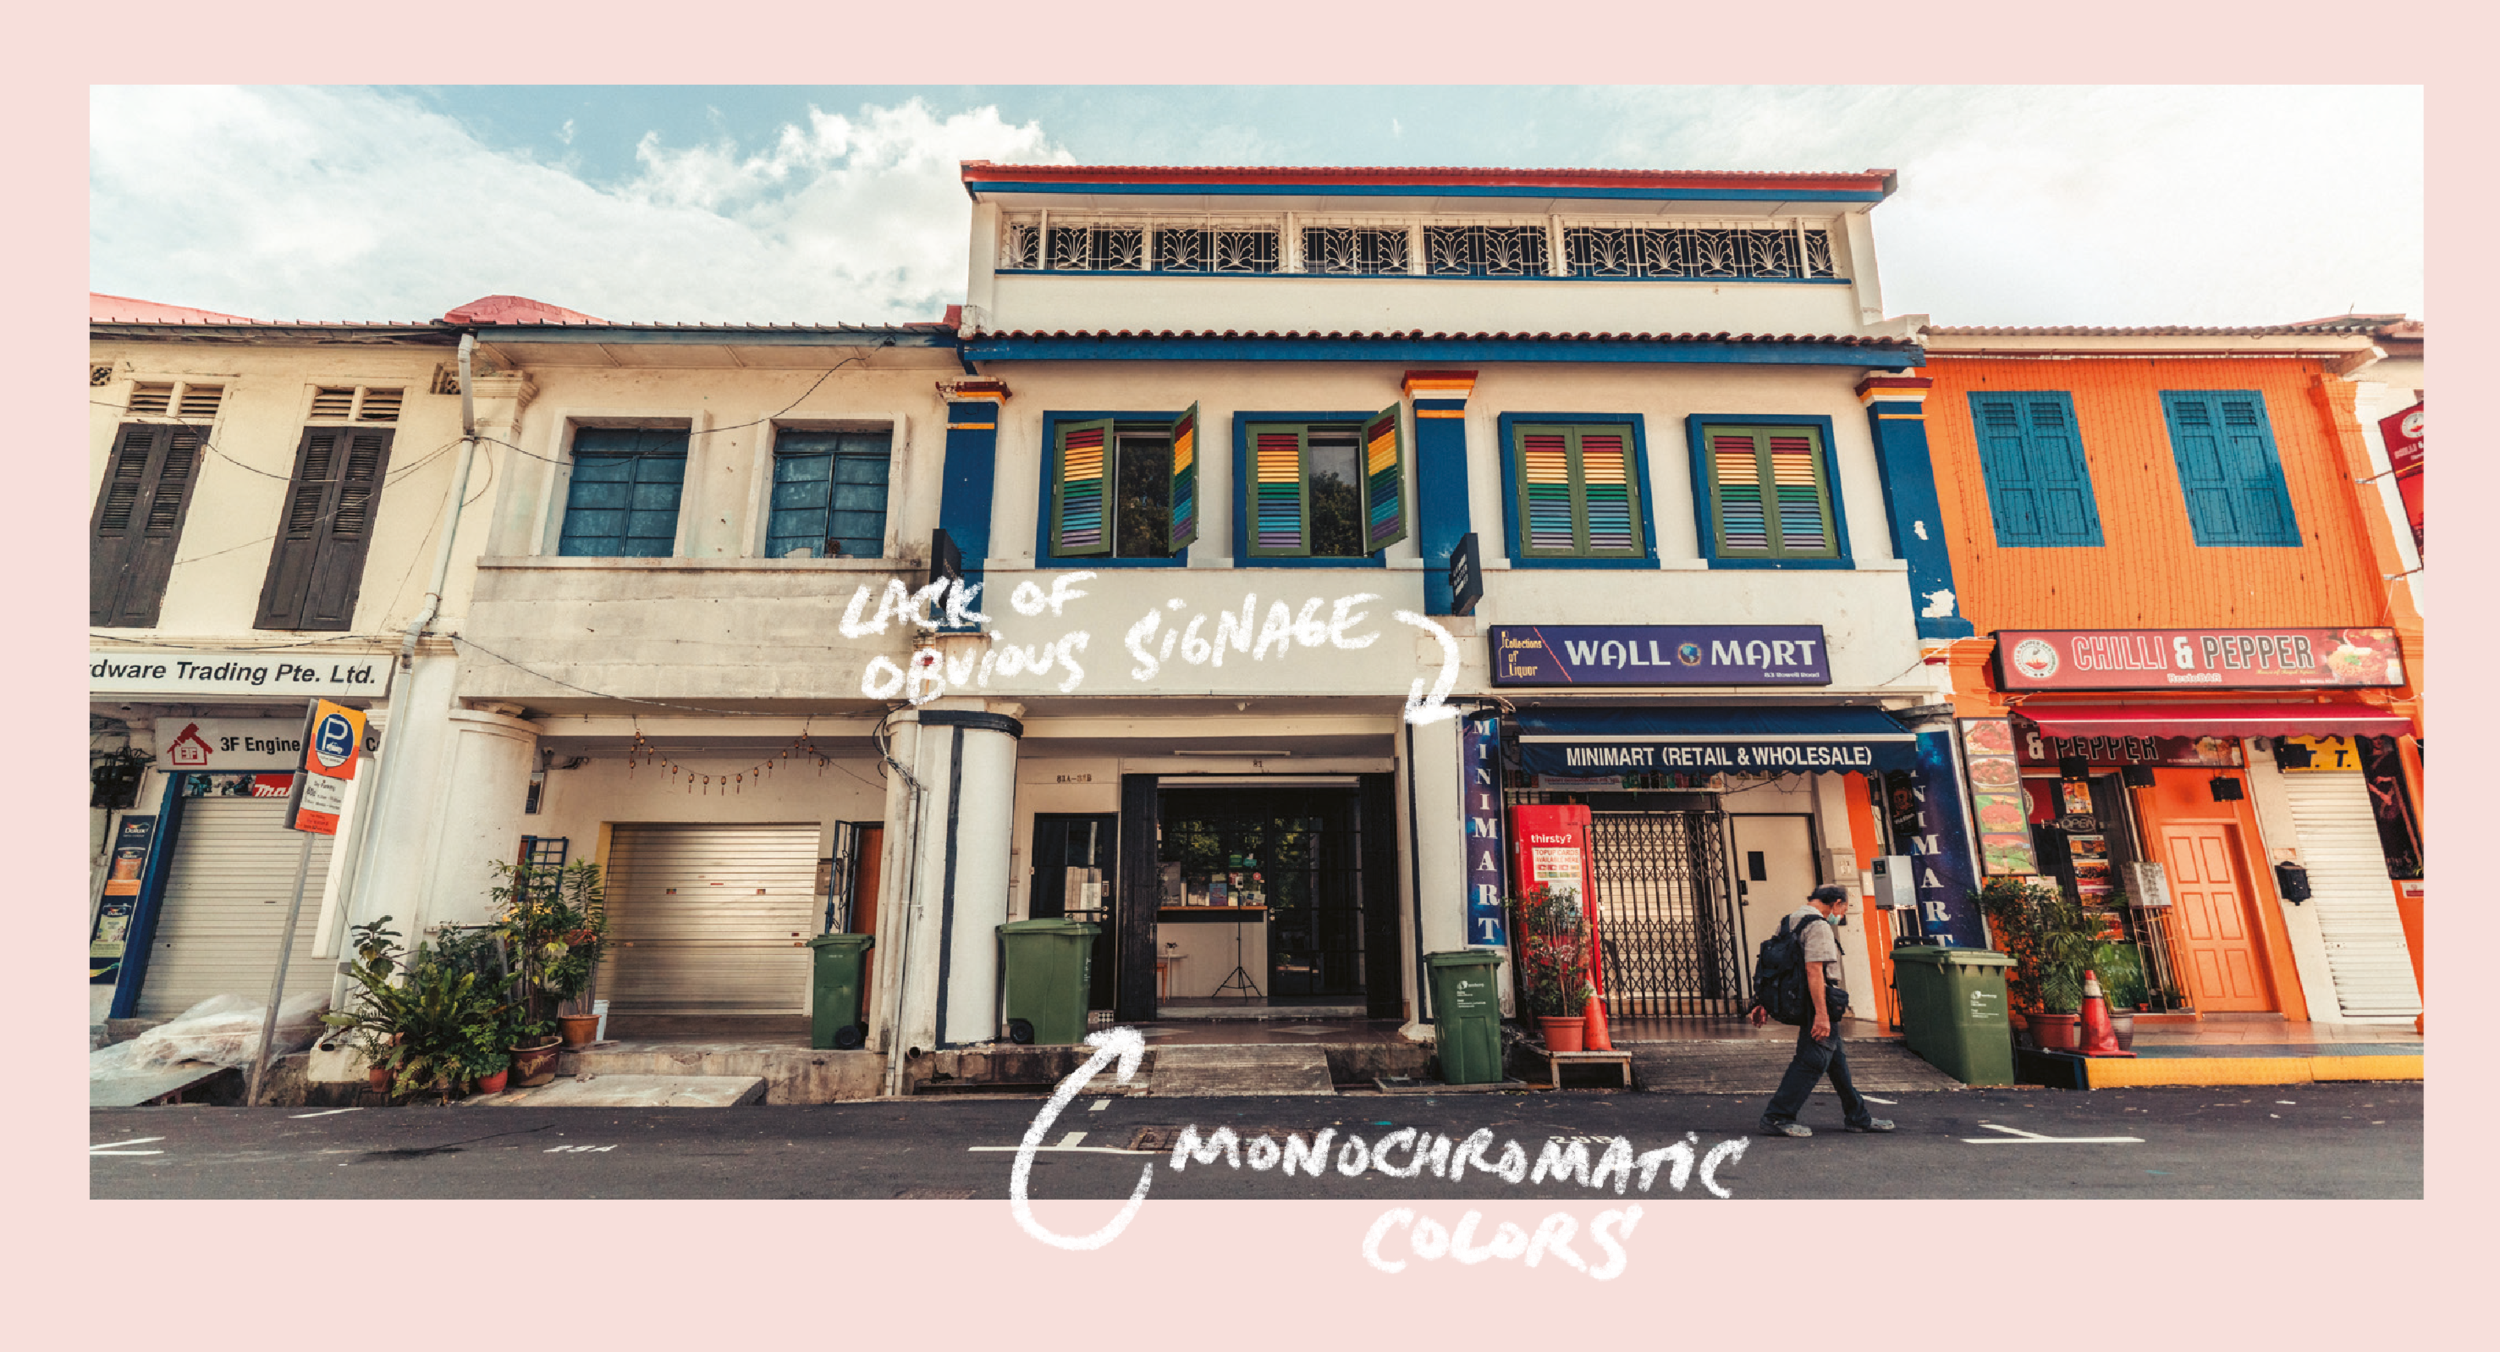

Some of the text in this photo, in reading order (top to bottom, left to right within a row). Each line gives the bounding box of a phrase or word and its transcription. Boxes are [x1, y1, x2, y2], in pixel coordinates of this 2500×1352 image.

[1508, 650, 1519, 662] of
[1565, 640, 1816, 669] WALL MART
[2071, 636, 2167, 670] CHILLI
[2174, 636, 2196, 670] &
[2202, 635, 2316, 669] PEPPER
[89, 659, 376, 686] dware Trading Pte. Ltd.
[1509, 663, 1538, 678] Liquor
[220, 737, 239, 751] 3F
[321, 717, 349, 751] P
[2026, 732, 2045, 759] &
[1567, 746, 1872, 766] MINIMART (RETAIL & WHOLESALE)
[1472, 720, 1499, 940] MINIMART
[2061, 814, 2096, 829] OPEN
[1531, 834, 1572, 844] thirsty?
